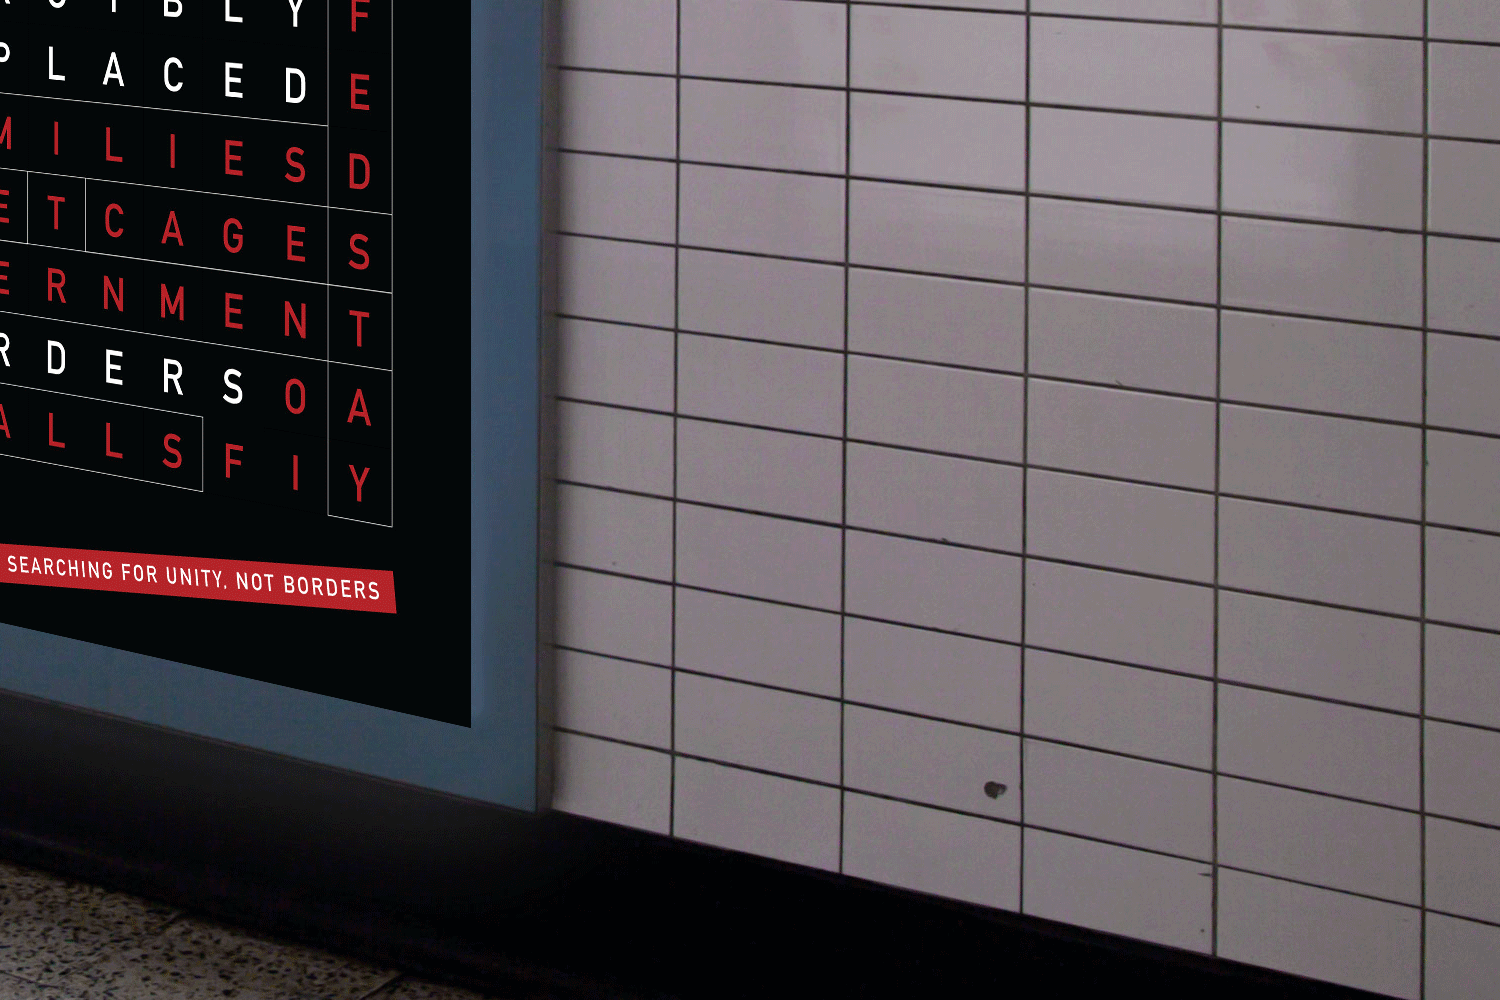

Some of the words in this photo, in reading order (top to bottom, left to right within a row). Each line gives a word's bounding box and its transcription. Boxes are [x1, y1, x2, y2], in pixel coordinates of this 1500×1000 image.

[7, 554, 113, 580] SEARCHING
[121, 563, 158, 584] FOR
[165, 566, 227, 590] UNITY,
[236, 571, 274, 592] NOT
[283, 574, 380, 601] BORDERS
